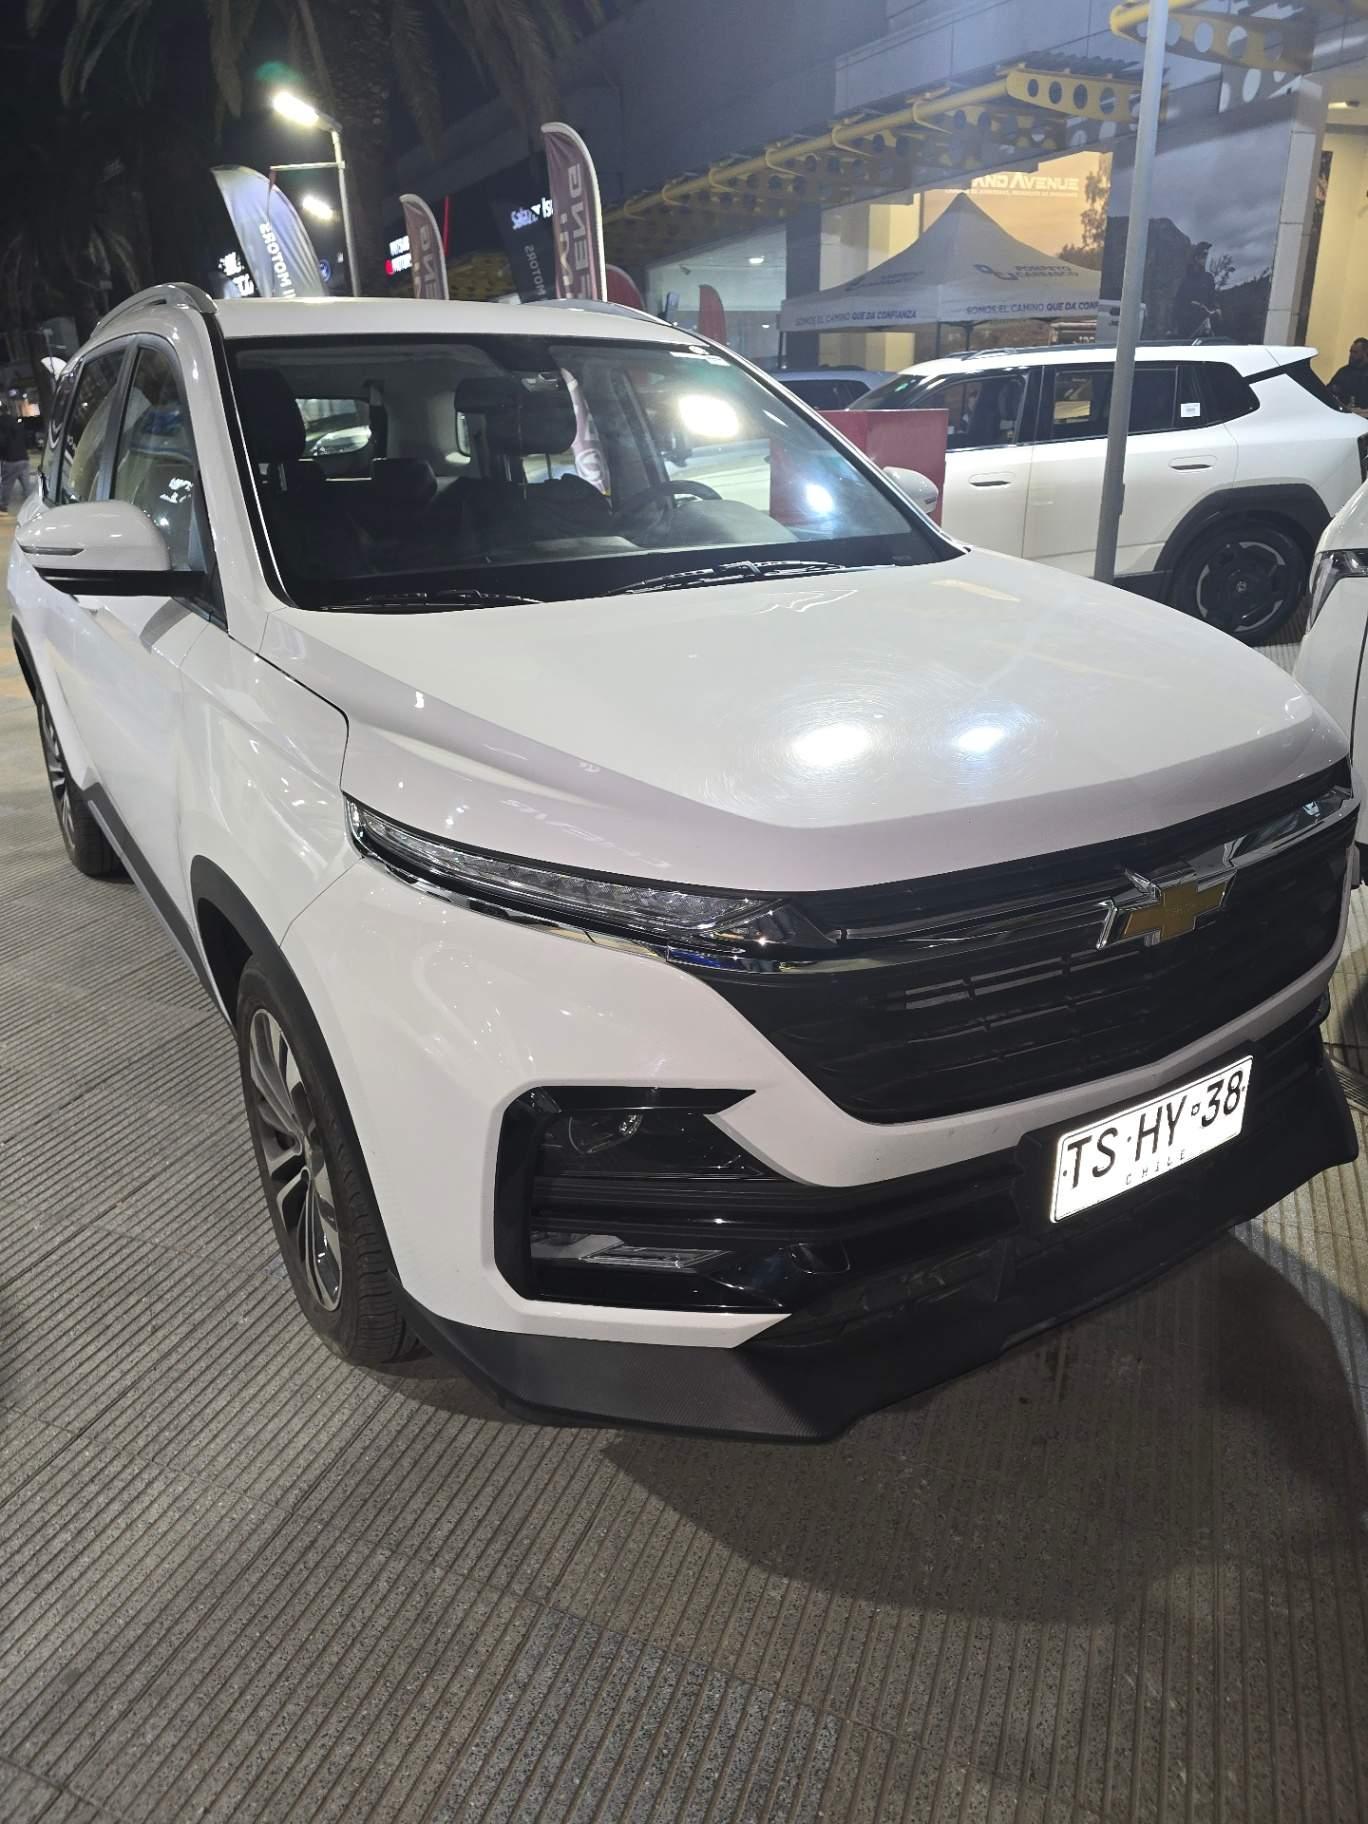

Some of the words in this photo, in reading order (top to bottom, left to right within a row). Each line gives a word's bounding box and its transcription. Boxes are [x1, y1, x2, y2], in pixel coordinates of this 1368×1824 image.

[971, 173, 1008, 188] AND
[1010, 172, 1080, 191] AVENUE
[851, 311, 865, 320] QUE
[877, 310, 917, 320] CONFIANZA
[966, 305, 997, 315] SOMOS
[999, 304, 1009, 313] EL
[1011, 303, 1046, 313] CAMINO
[1047, 302, 1064, 312] QUE
[1065, 302, 1076, 311] DA
[1126, 1149, 1185, 1186] CHILE
